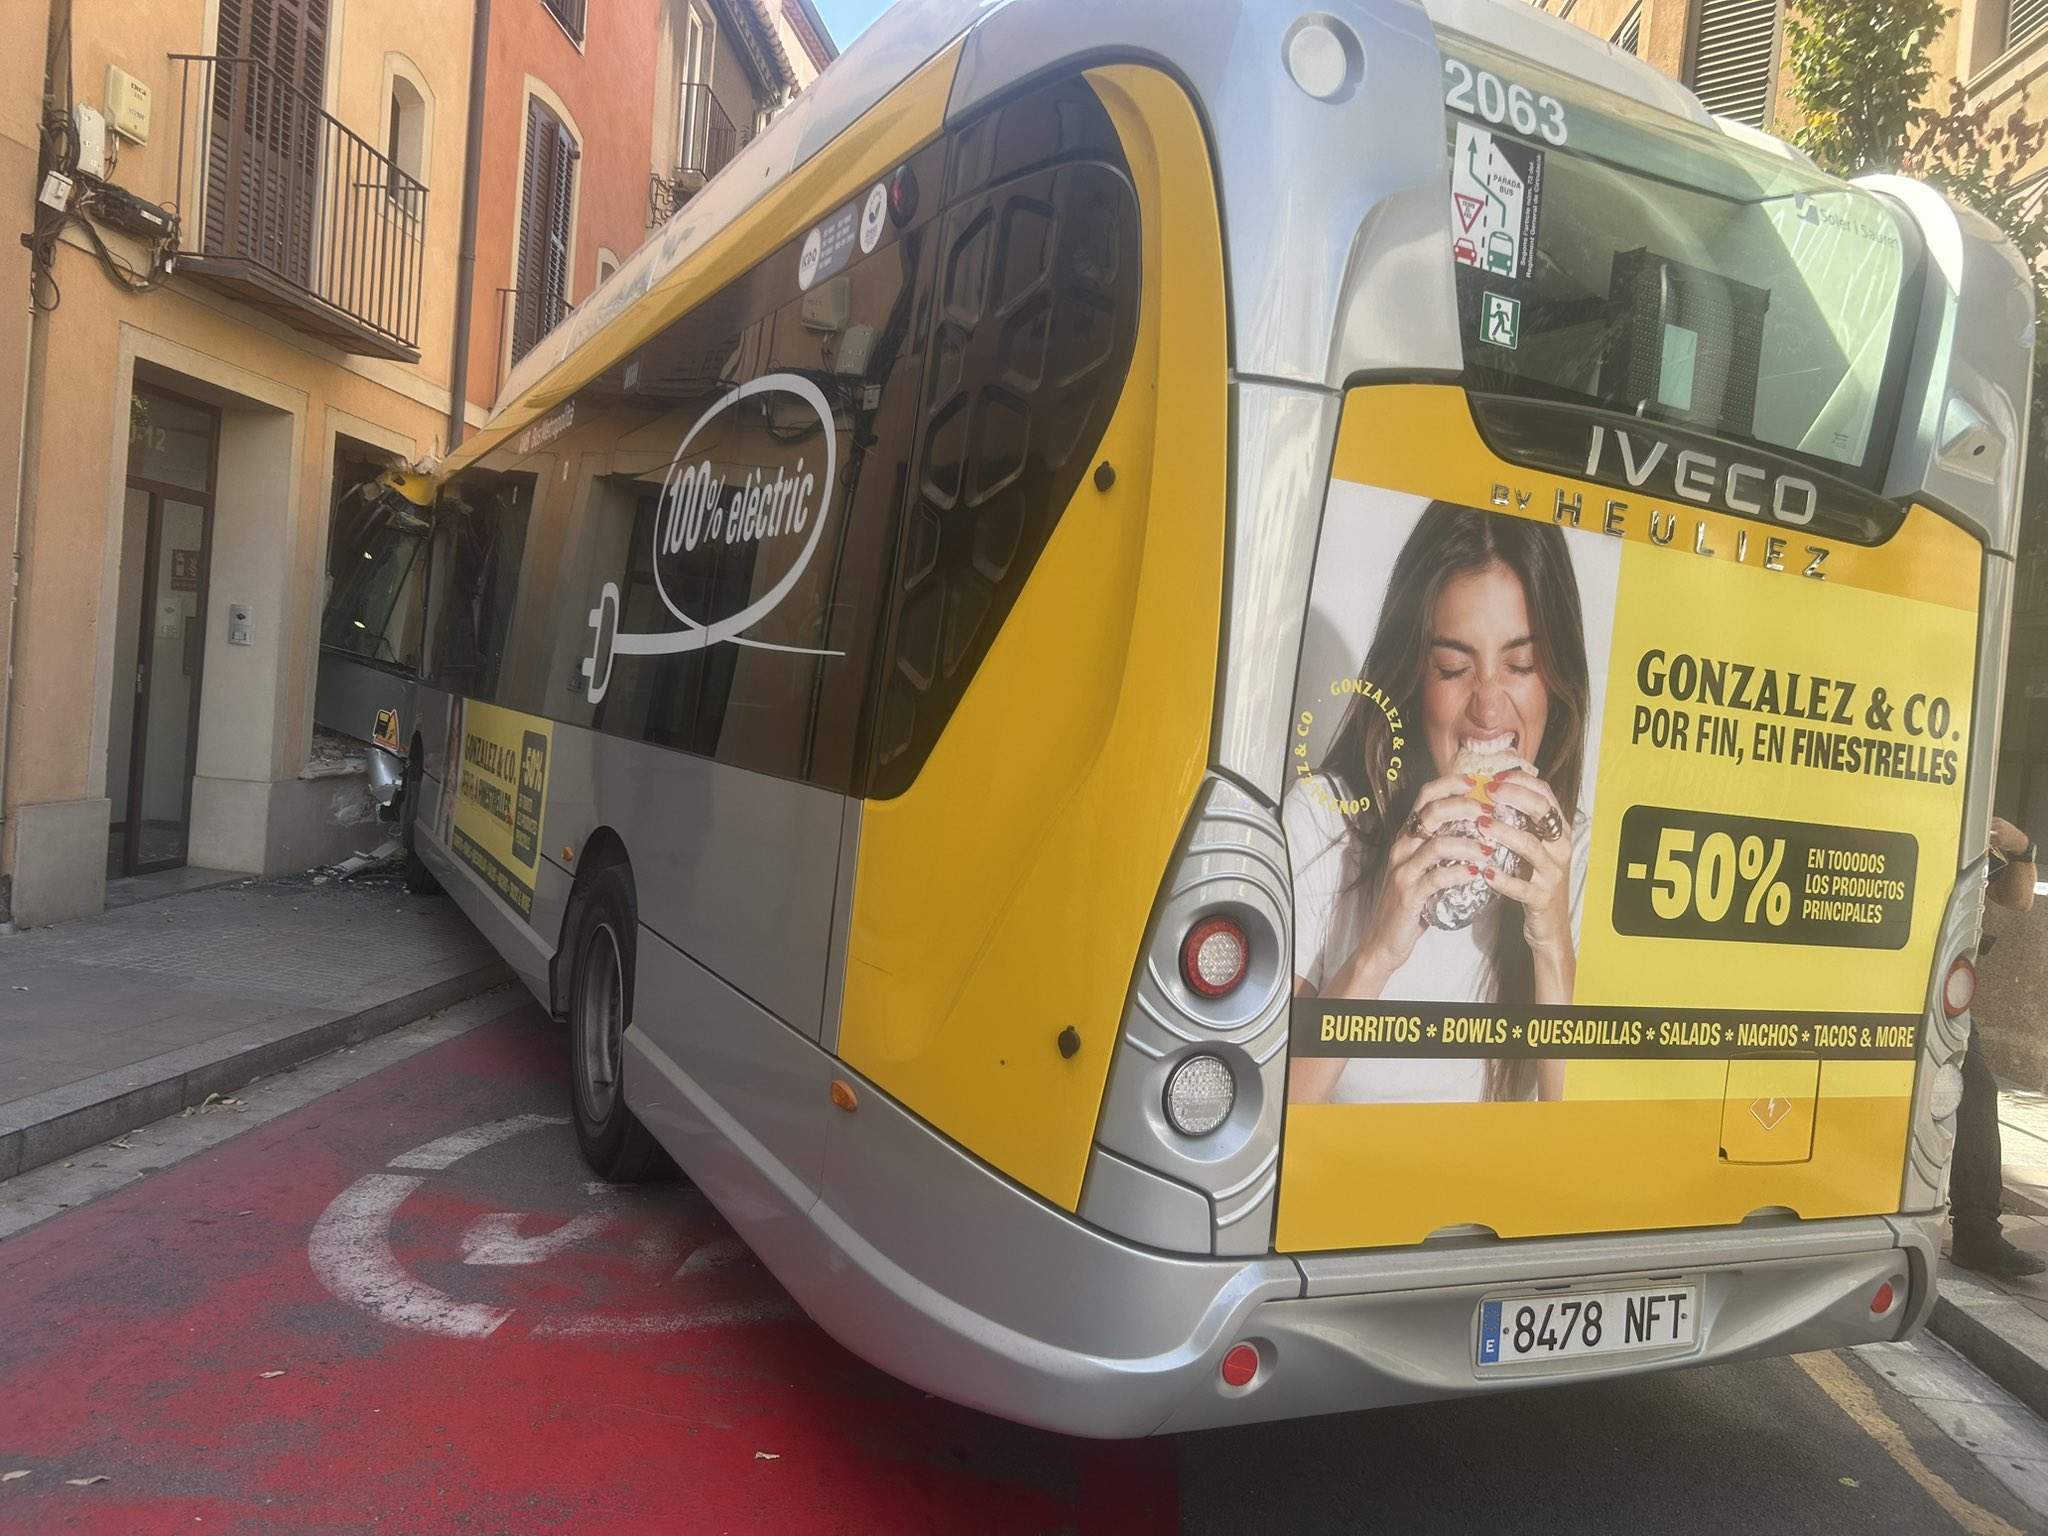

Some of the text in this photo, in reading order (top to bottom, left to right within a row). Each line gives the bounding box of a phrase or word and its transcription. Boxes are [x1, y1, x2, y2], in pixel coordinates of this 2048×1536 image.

[1445, 59, 1568, 146] 2063
[1493, 174, 1521, 188] PARADA
[1500, 186, 1514, 197] BUS
[1820, 207, 1850, 233] Soler
[1520, 237, 1528, 266] Segons
[1585, 425, 1817, 525] IVECO
[662, 457, 814, 555] 100% elèctric
[1554, 487, 1831, 581] HEULIEZ
[1330, 678, 1403, 733] GONZALEZ
[1392, 736, 1404, 750] &
[1636, 648, 1960, 742] GONZALEZ & CO.
[1294, 743, 1307, 757] &
[1632, 705, 1958, 786] POR FIN, EN FINESTRELLES
[522, 746, 544, 793] -50%
[1627, 827, 1792, 927] -50%
[1807, 847, 1886, 874] EN TOOODOS
[1804, 873, 1905, 901] LOS PRODUCTOS
[1801, 899, 1884, 925] PRINCIPALES
[1320, 1014, 1915, 1048] BURRITOS BOWLS QUESADILLAS SALADS NACHOS TACOS & MORE
[1512, 1293, 1687, 1354] 8478 NFT
[1485, 1338, 1496, 1353] E
